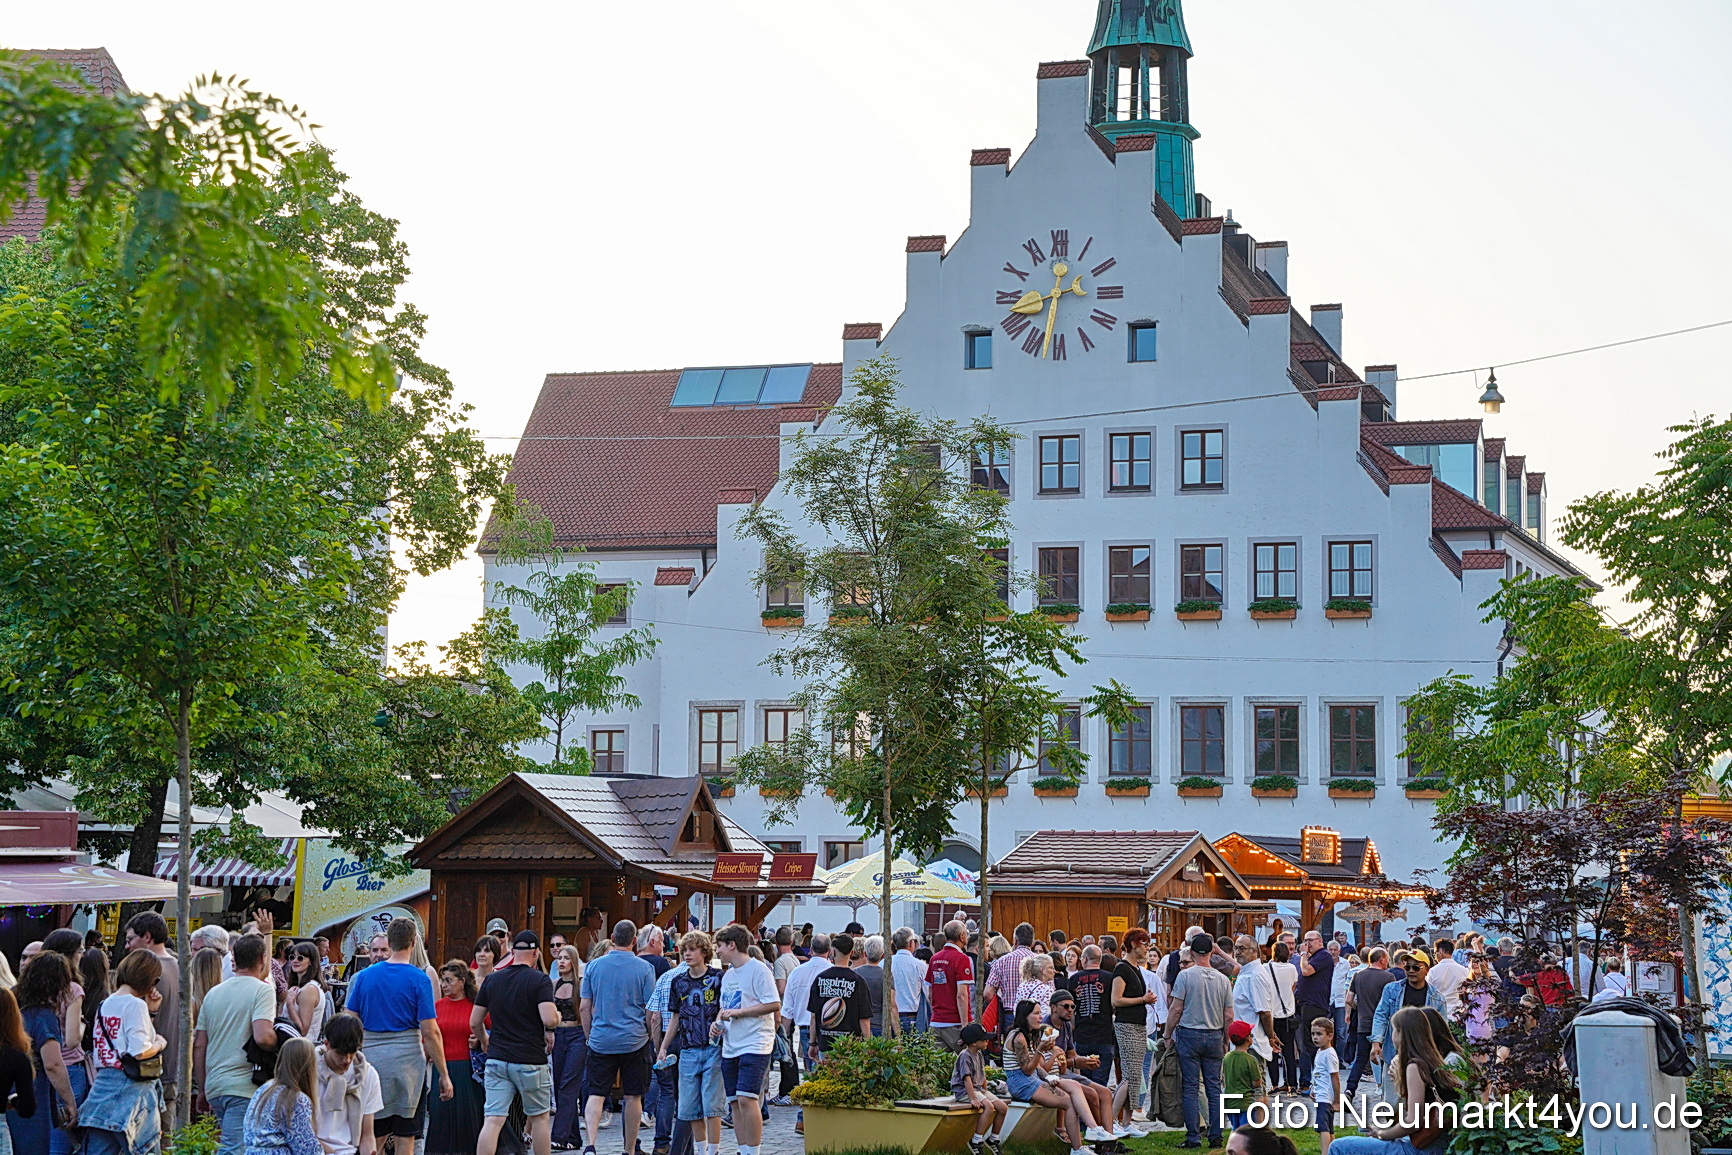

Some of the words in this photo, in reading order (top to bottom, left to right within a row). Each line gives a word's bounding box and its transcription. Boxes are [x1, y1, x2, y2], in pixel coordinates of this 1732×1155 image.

[1050, 229, 1068, 257] XII
[1003, 261, 1029, 282] X
[323, 855, 387, 891] Gloss
[716, 861, 738, 874] Heisser
[784, 861, 802, 876] Crêpes
[355, 875, 386, 891] Bier
[902, 878, 927, 886] Bier
[818, 977, 856, 992] Inspiring
[820, 985, 853, 998] Lifestyle
